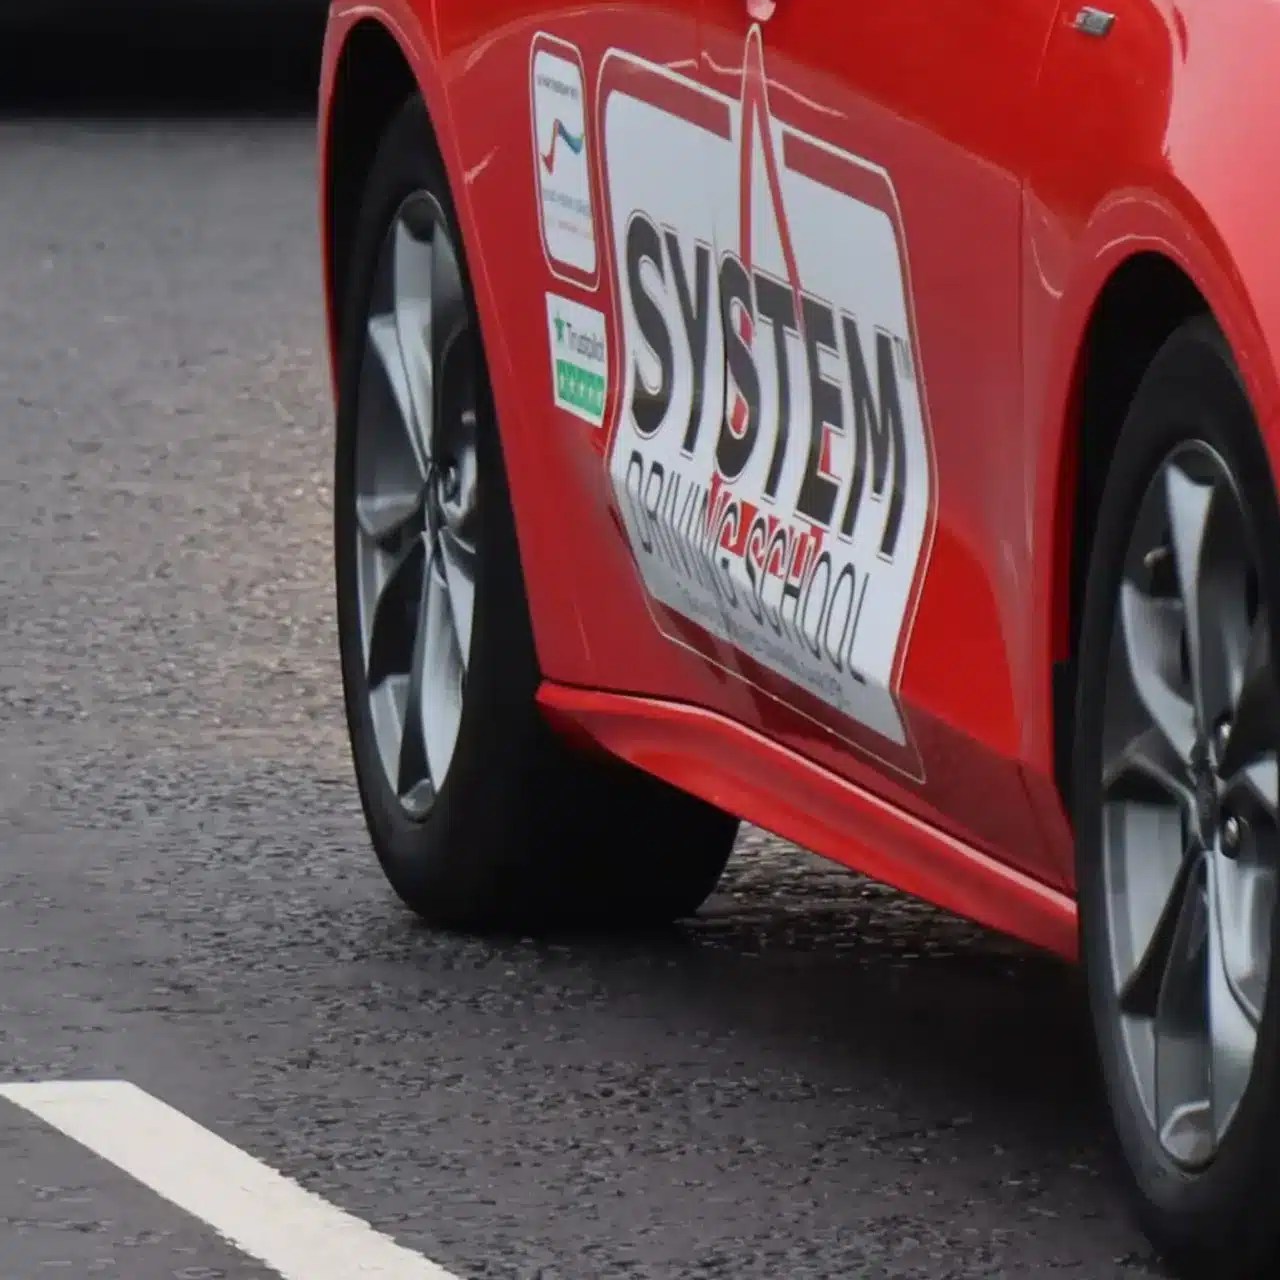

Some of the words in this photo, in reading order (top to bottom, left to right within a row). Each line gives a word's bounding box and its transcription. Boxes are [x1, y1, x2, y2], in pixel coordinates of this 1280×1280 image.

[624, 209, 909, 564] SYSTEM
[626, 449, 738, 608] DRIVING
[746, 516, 867, 686] SCHOOL
